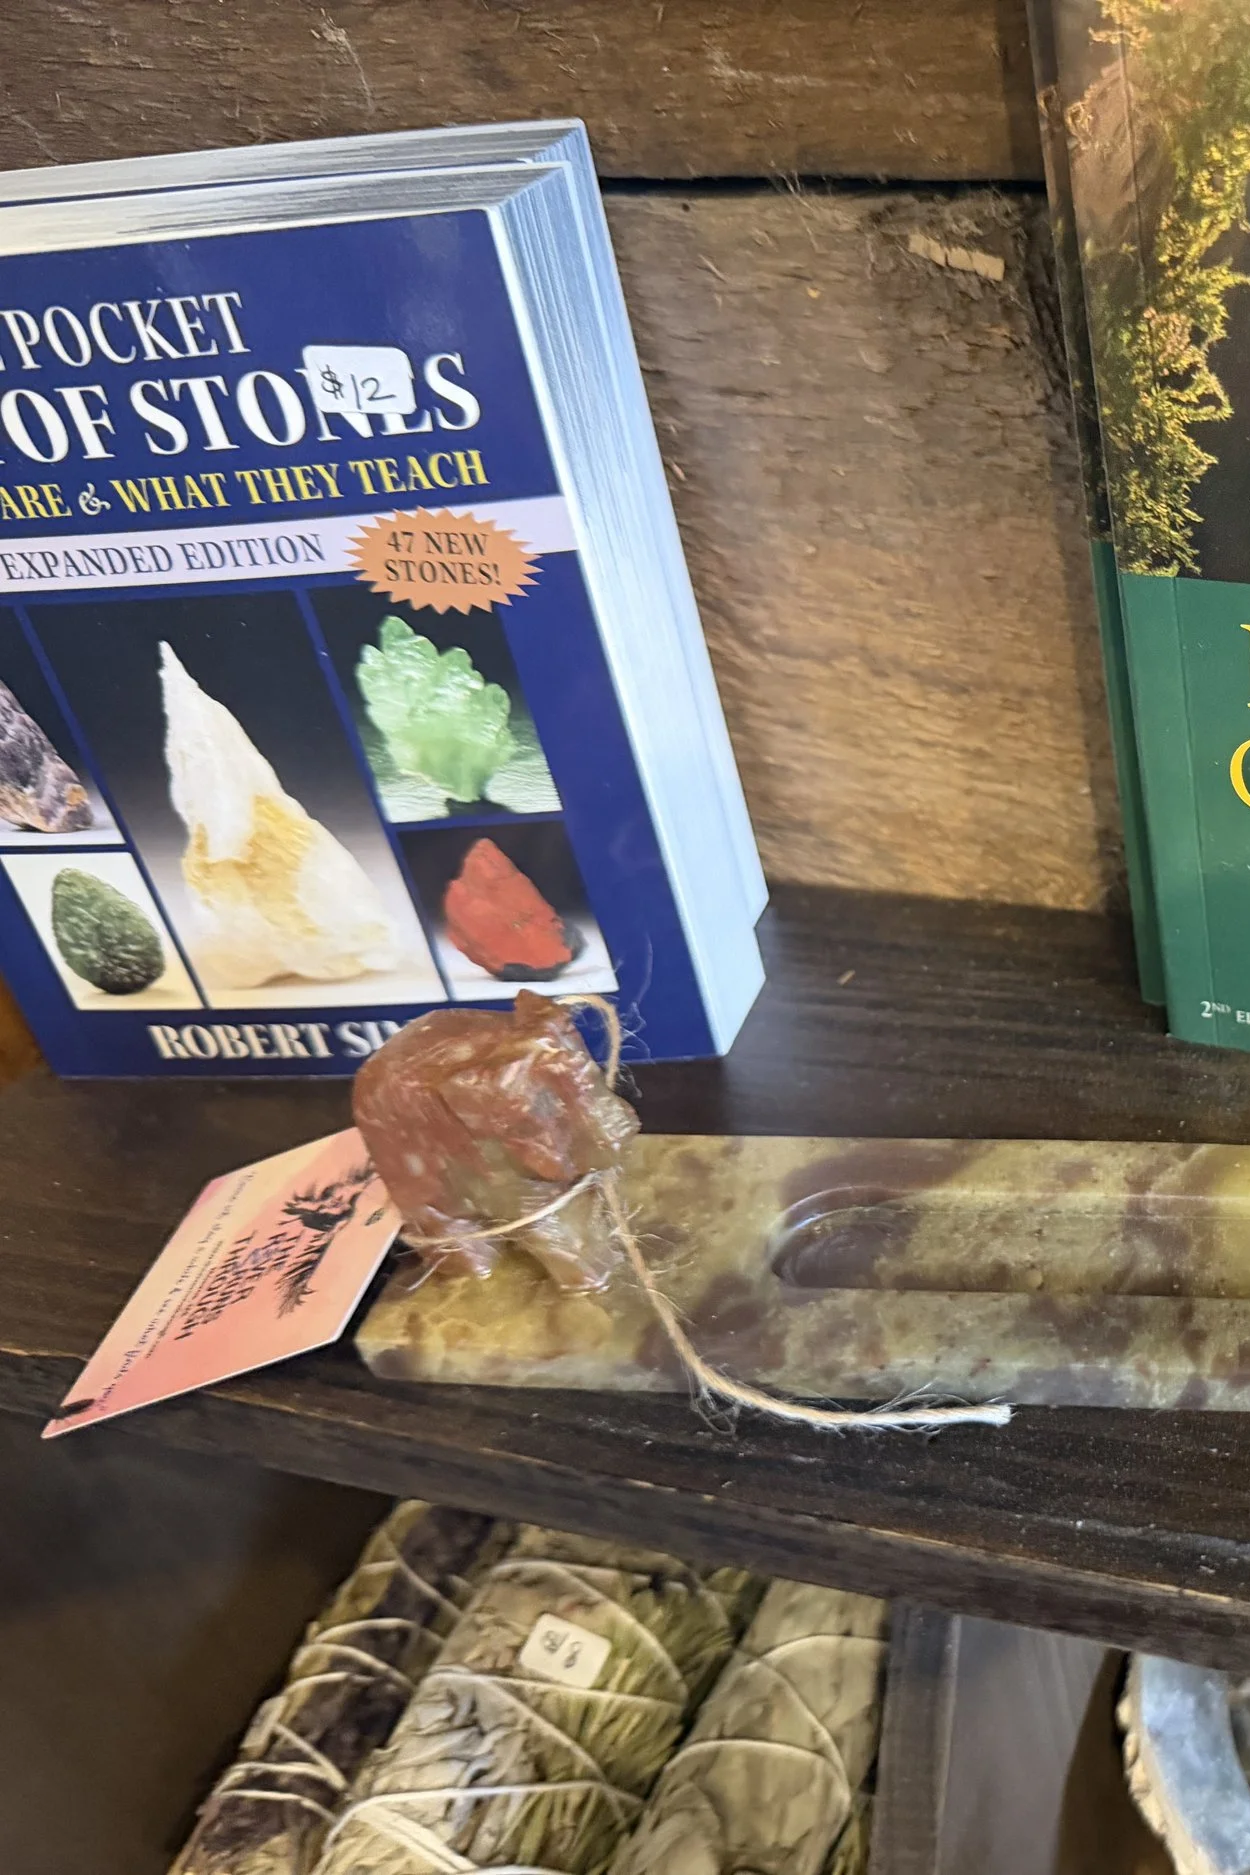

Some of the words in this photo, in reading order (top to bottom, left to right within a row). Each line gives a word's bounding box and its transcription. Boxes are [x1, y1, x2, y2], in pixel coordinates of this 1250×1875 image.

[0, 291, 251, 370] POCKET
[0, 384, 116, 463] OF
[129, 351, 481, 456] STOS
[320, 364, 397, 410] $12
[0, 483, 73, 520] ARE
[78, 482, 111, 516] &
[109, 473, 231, 512] WHAT
[234, 462, 344, 505] THEY
[348, 449, 490, 495] TEACH
[0, 544, 174, 580] EXPANDED
[177, 532, 328, 570] EDITION
[385, 531, 418, 555] 47
[425, 530, 490, 557] NEW
[383, 557, 502, 588] STONES!
[1200, 1000, 1231, 1019] 2ND
[147, 1022, 334, 1060] ROBERT
